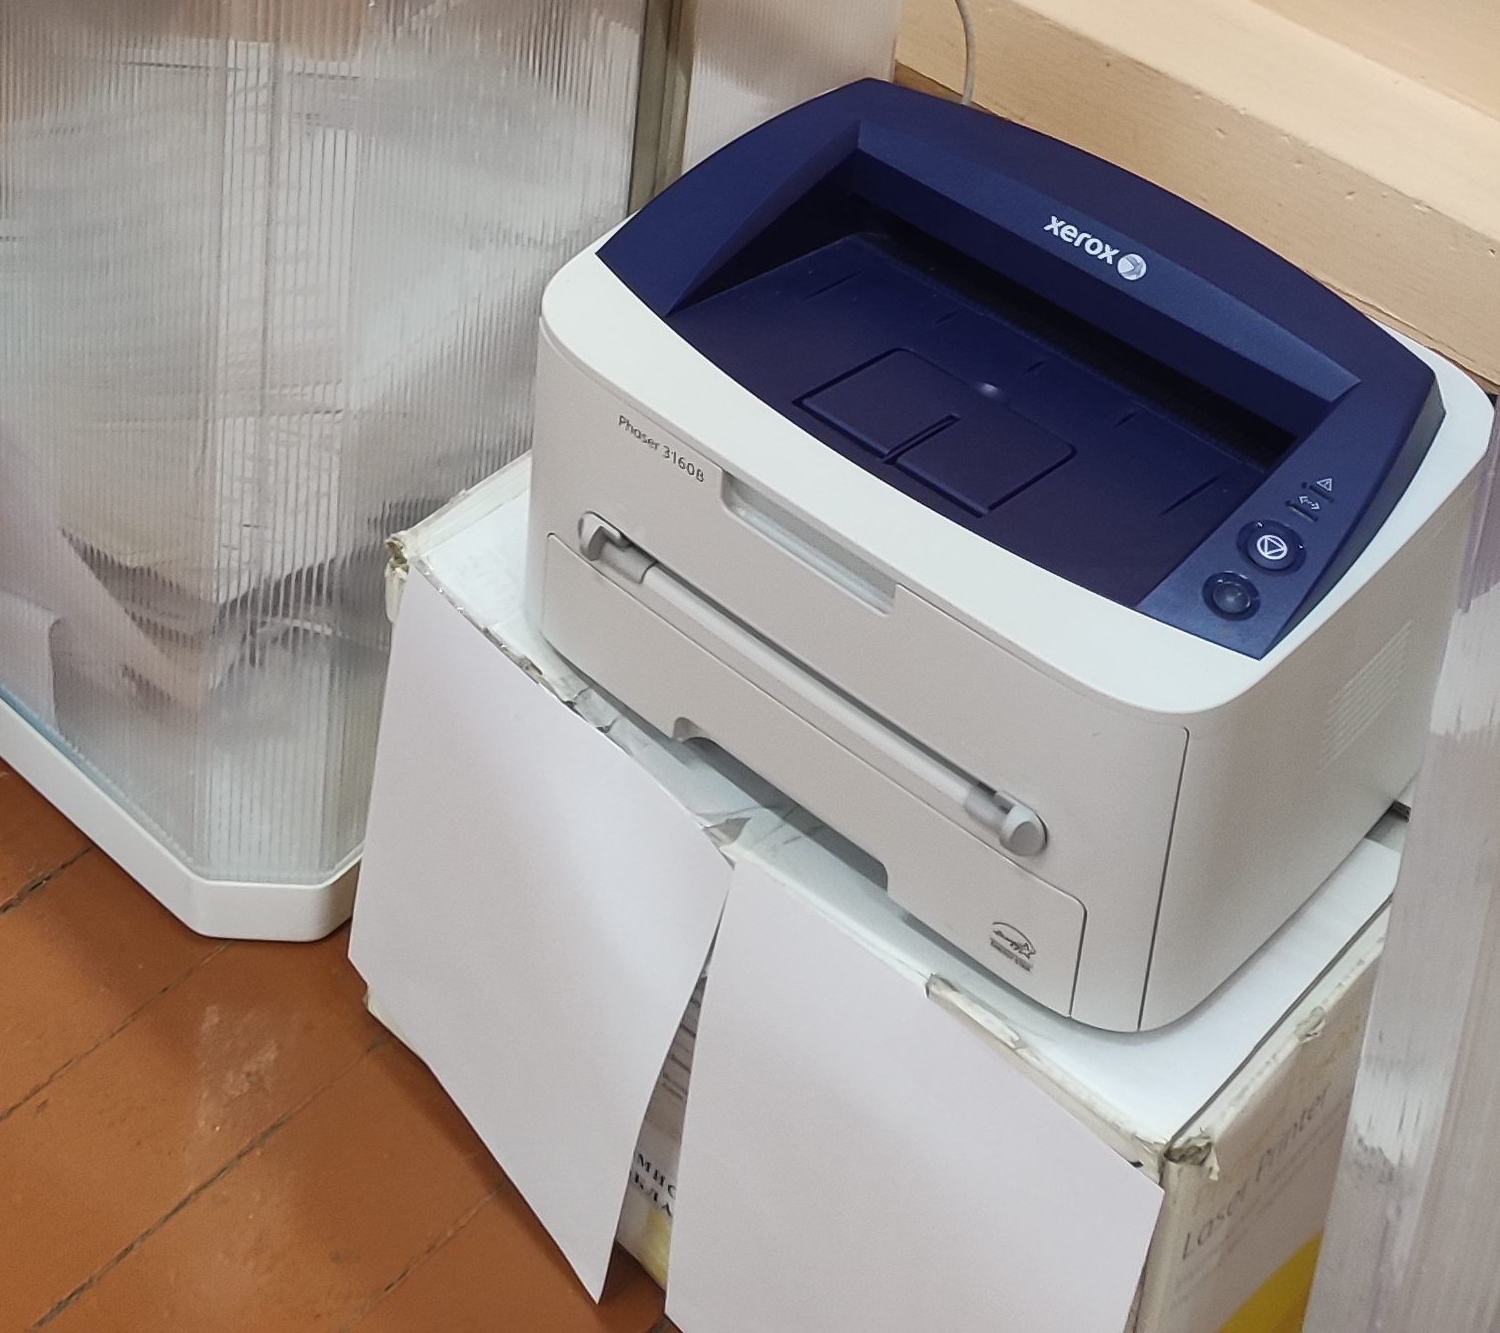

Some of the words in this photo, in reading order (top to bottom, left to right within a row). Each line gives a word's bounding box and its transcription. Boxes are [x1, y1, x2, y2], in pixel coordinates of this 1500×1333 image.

[1043, 215, 1120, 265] xerox
[618, 415, 660, 450] Phaser
[1183, 1183, 1246, 1260] Laser
[1256, 1085, 1330, 1183] Printer
